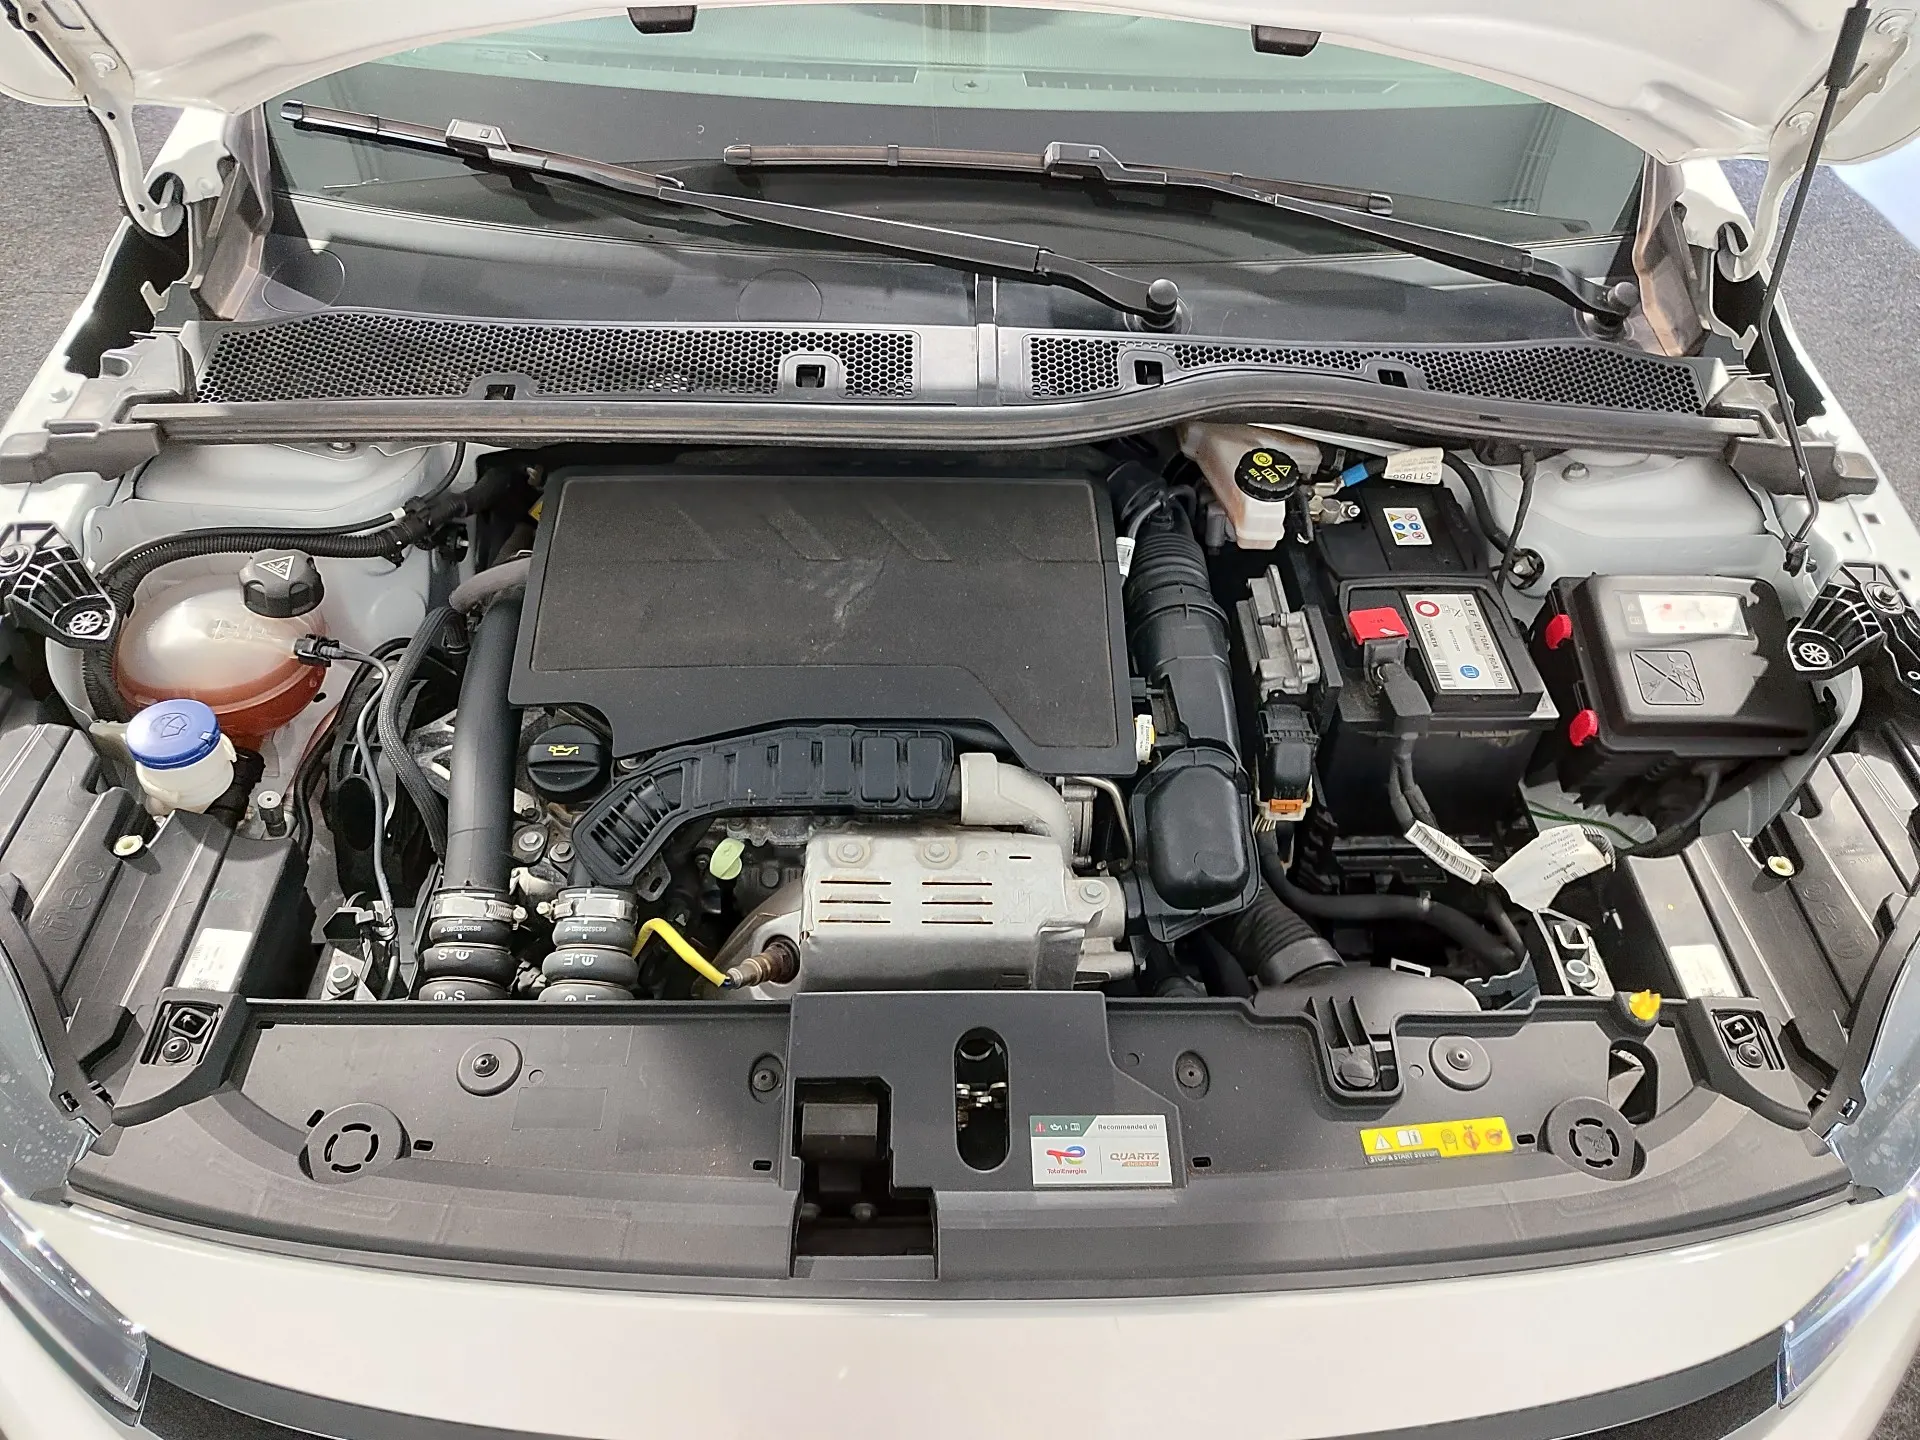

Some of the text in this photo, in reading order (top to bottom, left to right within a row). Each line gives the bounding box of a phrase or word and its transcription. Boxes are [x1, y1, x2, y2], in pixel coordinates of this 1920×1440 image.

[1109, 1152, 1160, 1161] QUARTZ
[1370, 1155, 1386, 1163] STOP
[1394, 1153, 1413, 1161] START
